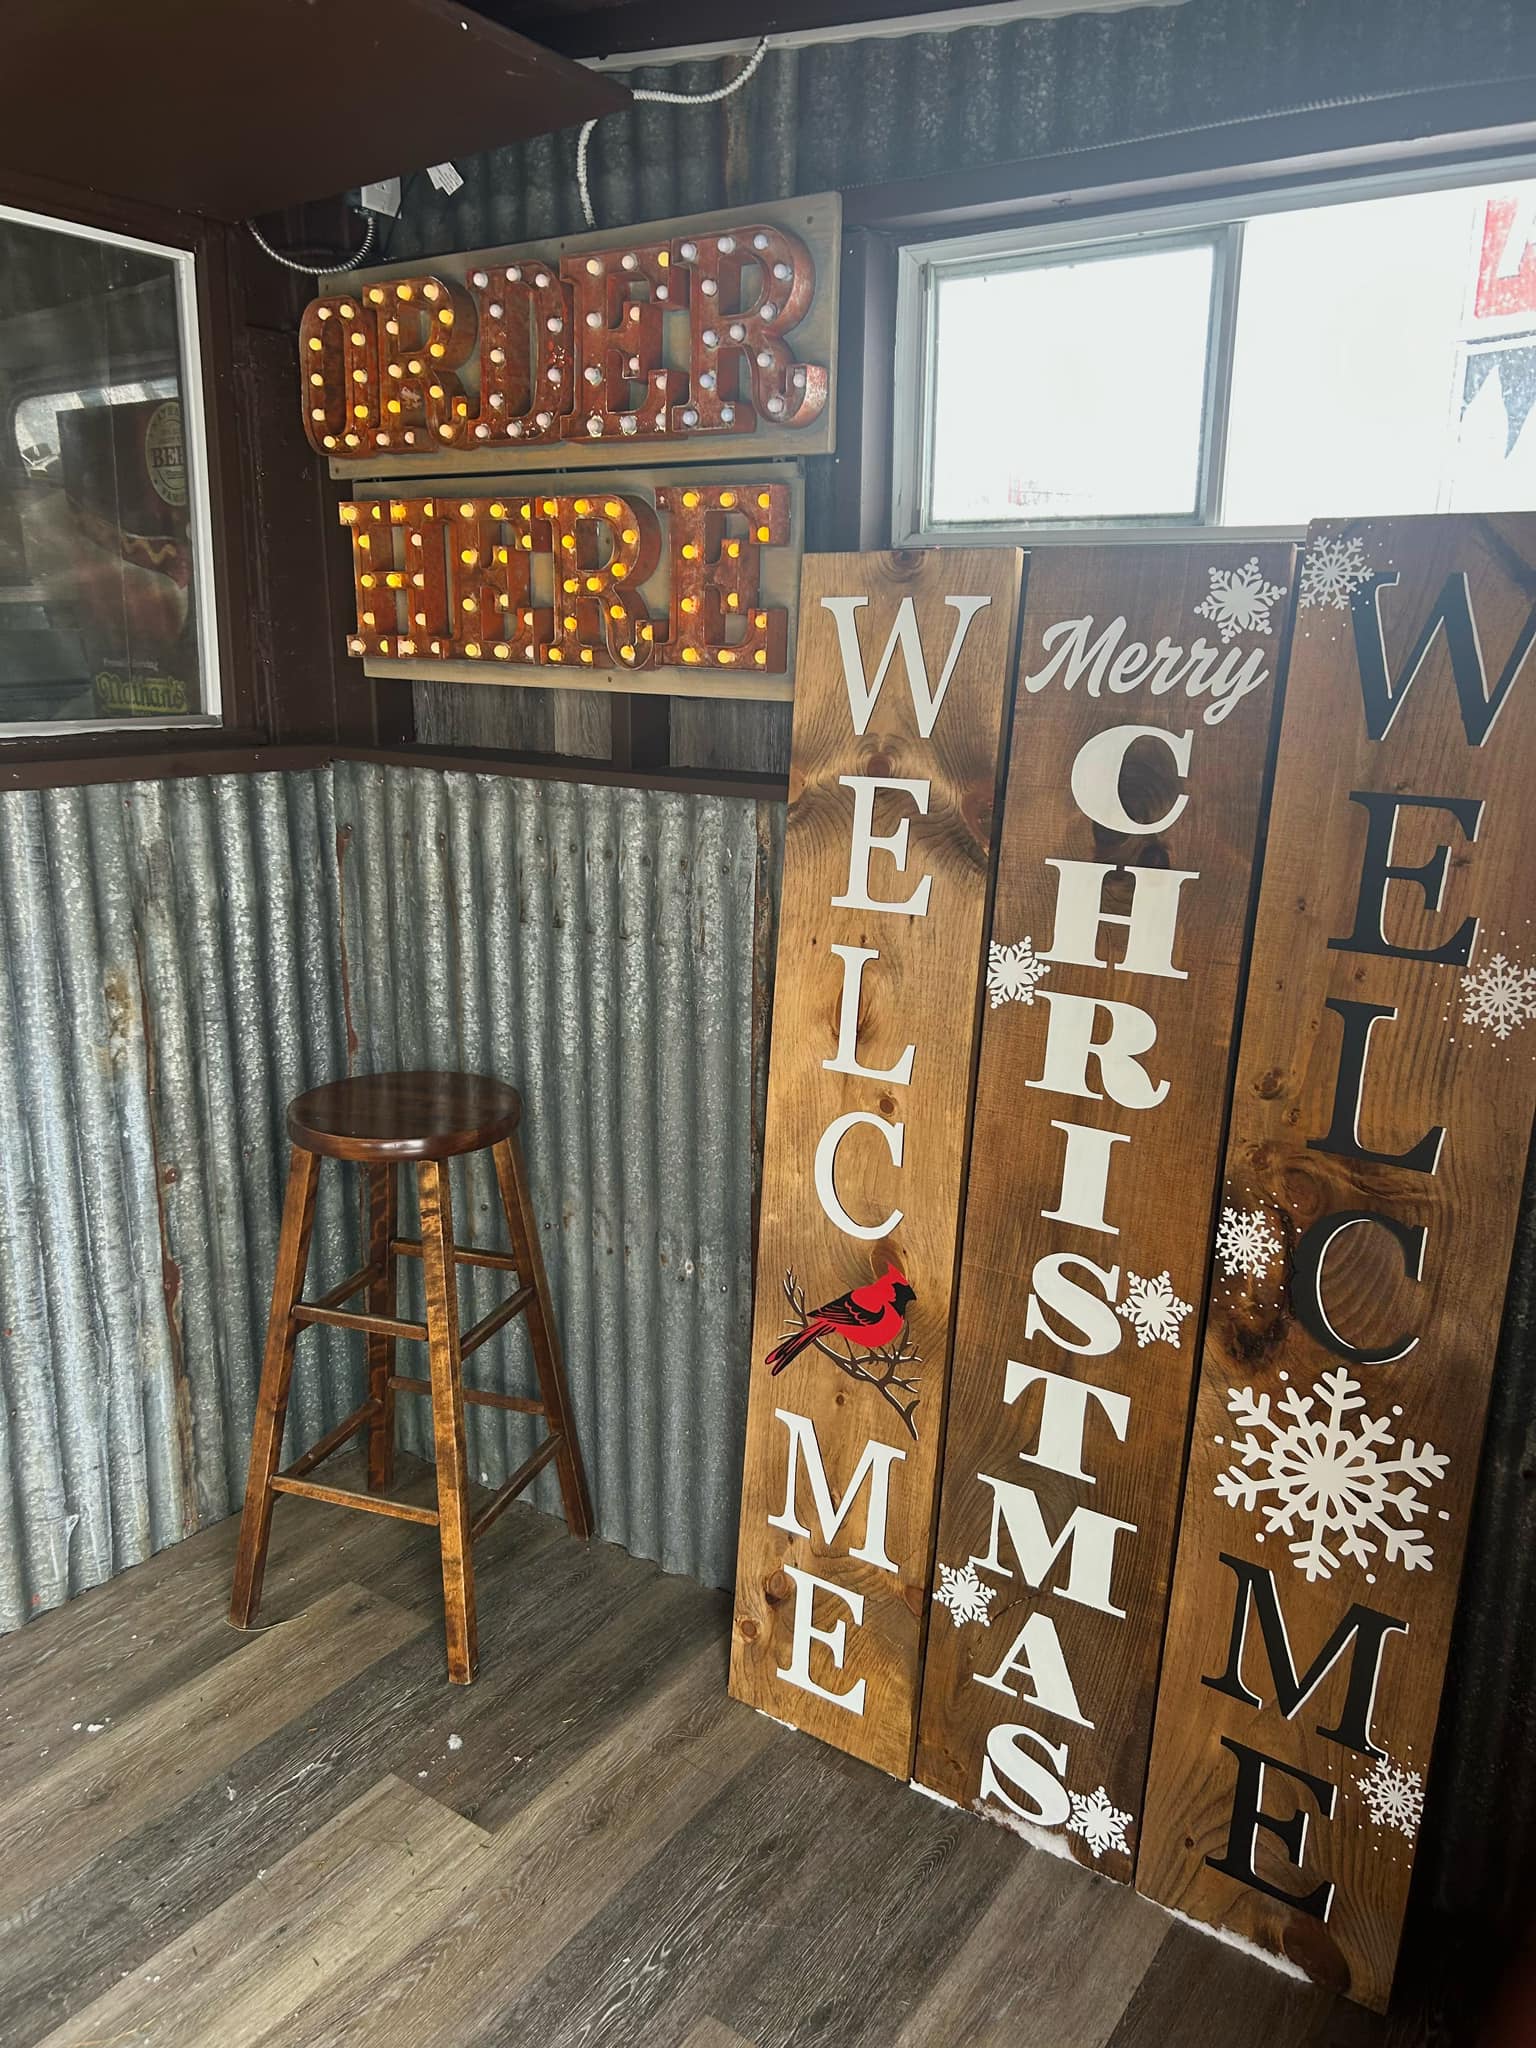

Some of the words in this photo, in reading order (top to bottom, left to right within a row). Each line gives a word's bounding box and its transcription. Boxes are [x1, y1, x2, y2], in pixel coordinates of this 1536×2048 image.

[300, 224, 827, 456] ORDER
[338, 484, 790, 672] HERE
[1025, 615, 1270, 726] Merry
[976, 723, 1200, 1828] CHRISTMAS
